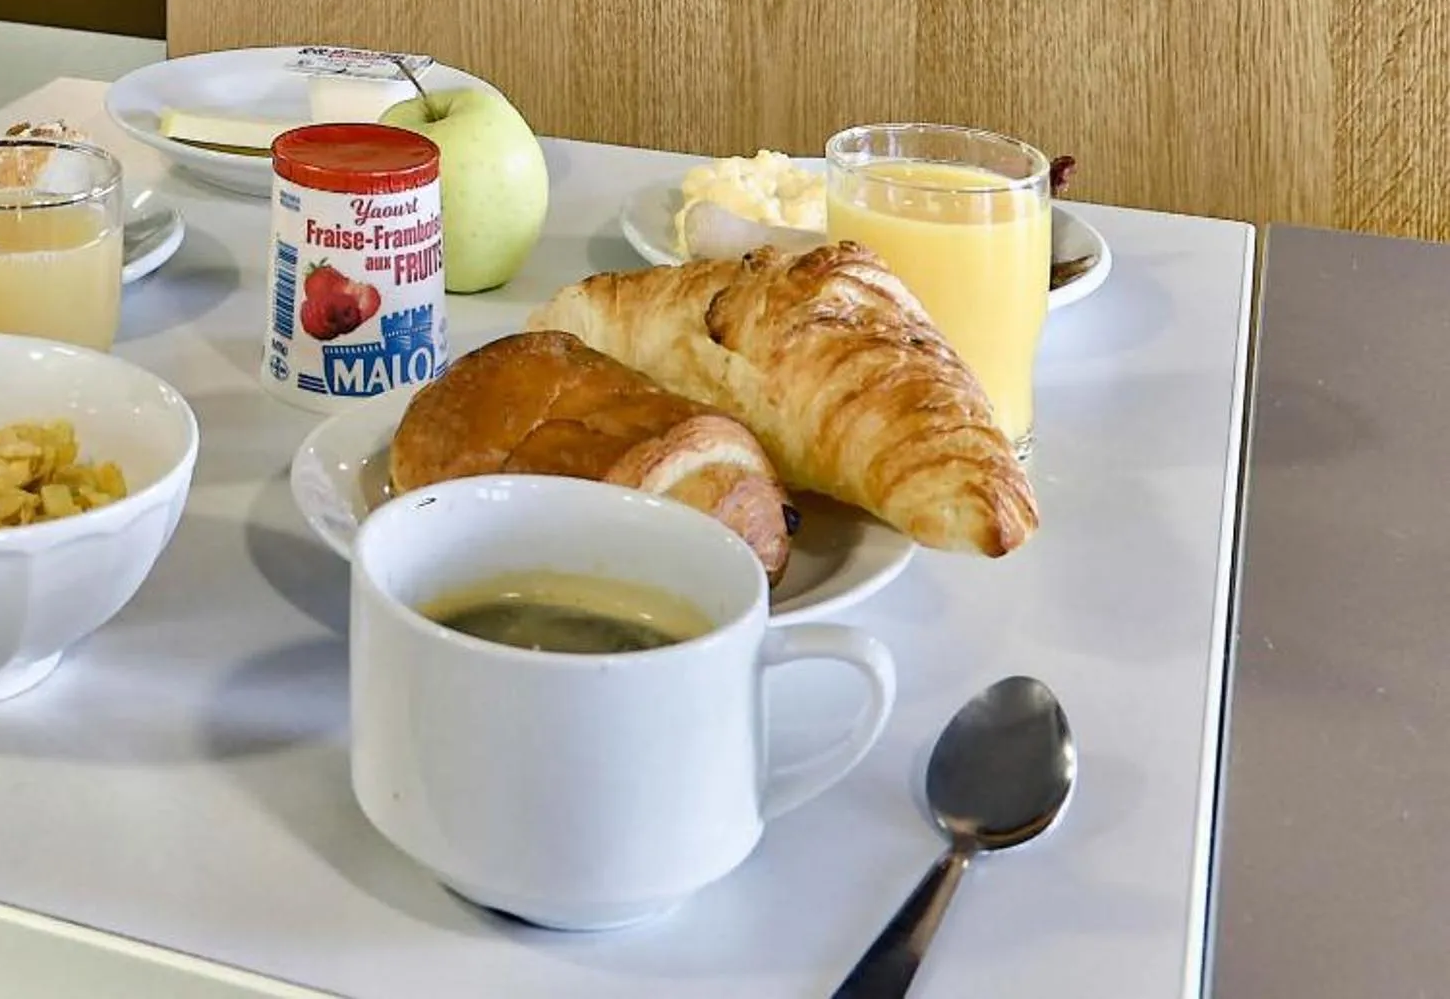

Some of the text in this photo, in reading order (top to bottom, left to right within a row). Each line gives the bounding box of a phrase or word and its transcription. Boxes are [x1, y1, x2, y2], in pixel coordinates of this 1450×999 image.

[350, 196, 418, 226] Yaourt
[306, 213, 441, 251] Fraise-Frambois
[365, 255, 392, 271] aux
[334, 347, 431, 393] MALO
